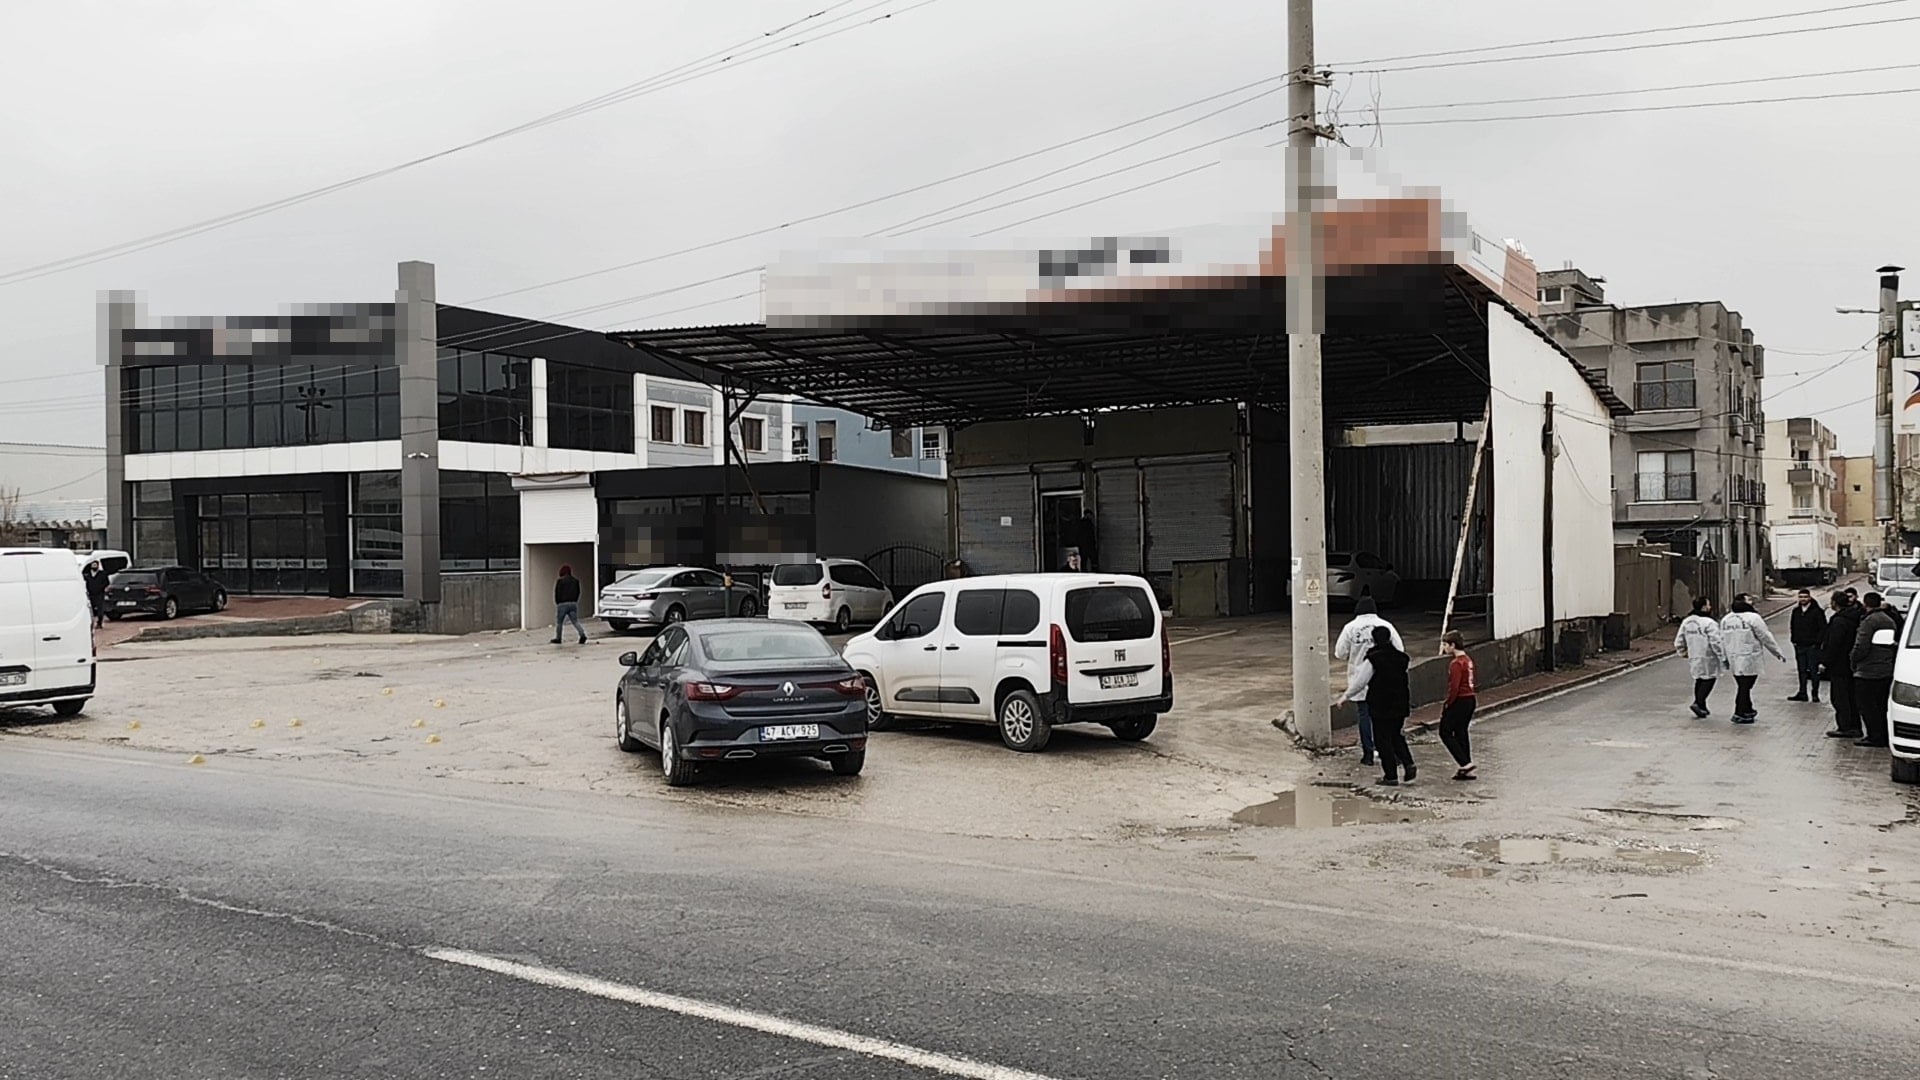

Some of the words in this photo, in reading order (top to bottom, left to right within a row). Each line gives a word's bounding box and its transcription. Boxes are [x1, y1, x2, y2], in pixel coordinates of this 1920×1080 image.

[766, 727, 776, 737] 47
[781, 725, 797, 736] ACV
[801, 724, 817, 735] 925
